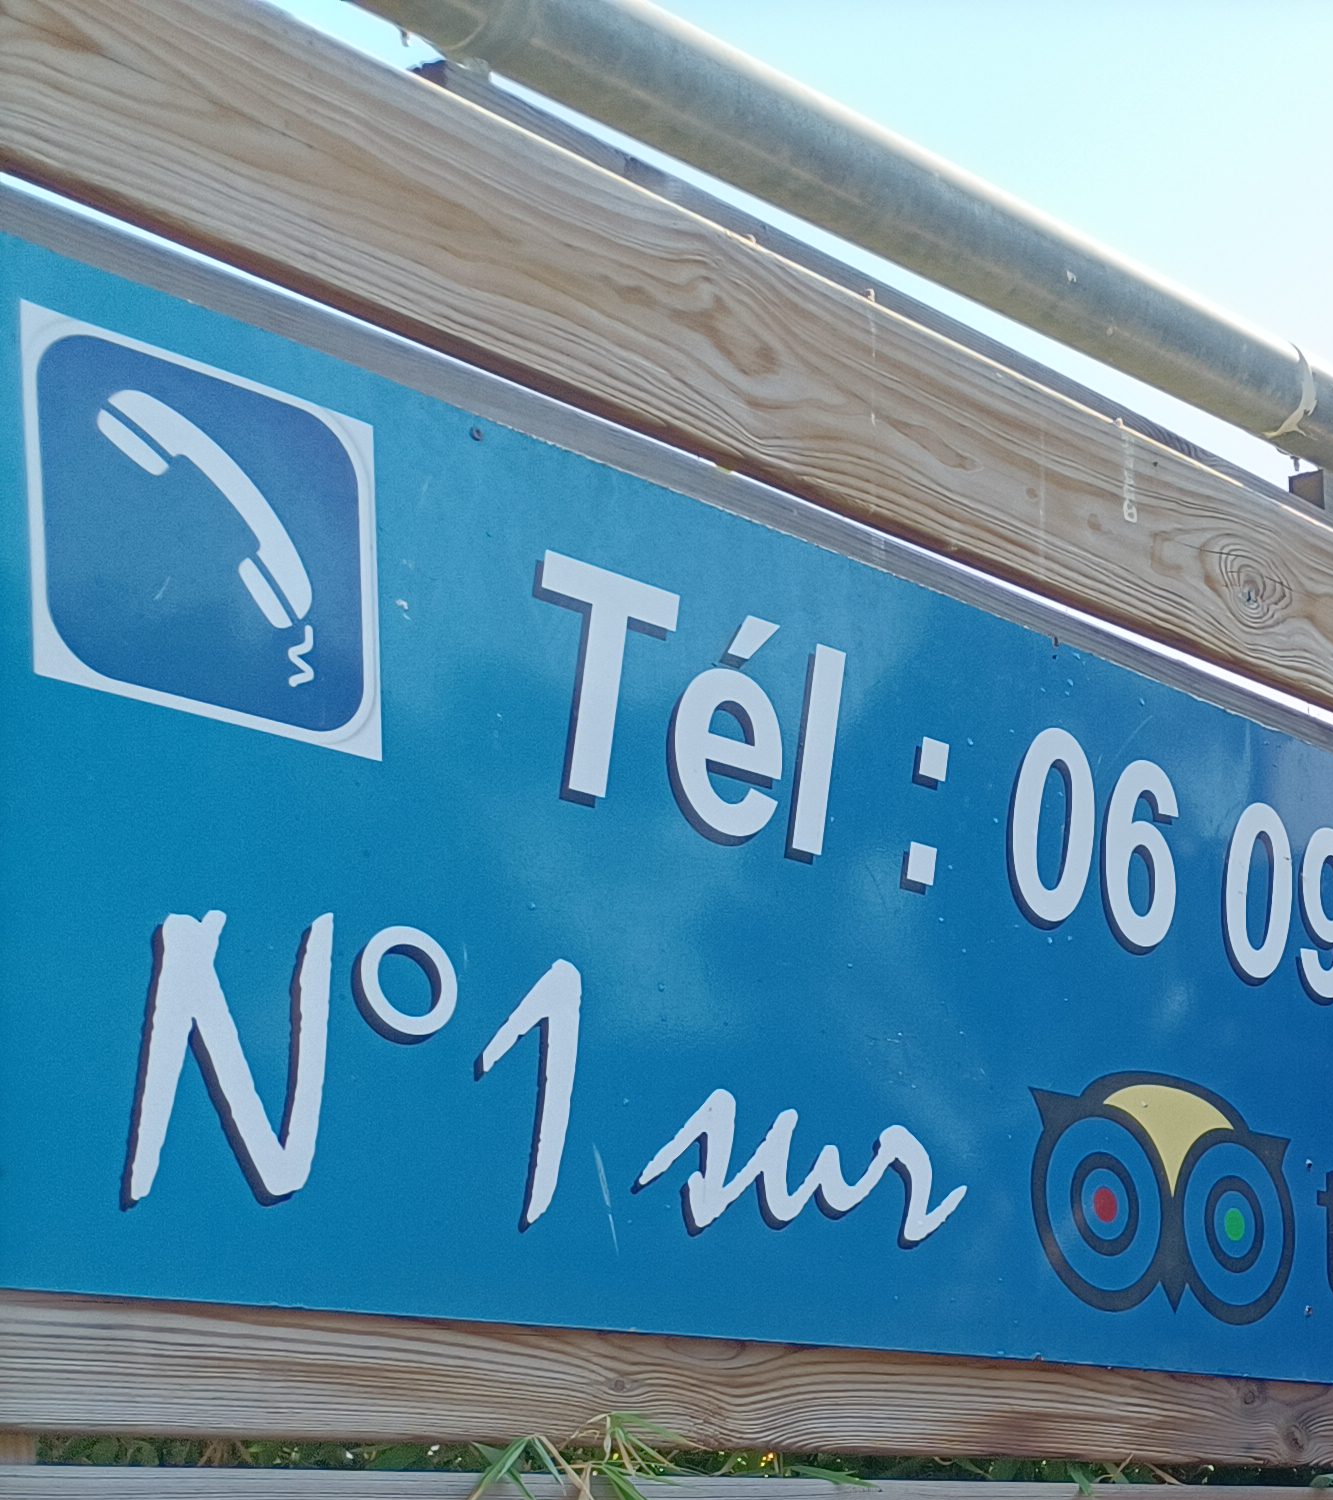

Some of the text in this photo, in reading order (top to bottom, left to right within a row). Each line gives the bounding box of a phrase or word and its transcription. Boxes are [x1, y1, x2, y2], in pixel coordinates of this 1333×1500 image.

[537, 549, 846, 857] Tél
[1010, 727, 1180, 952] 06
[634, 1088, 967, 1241] sur
